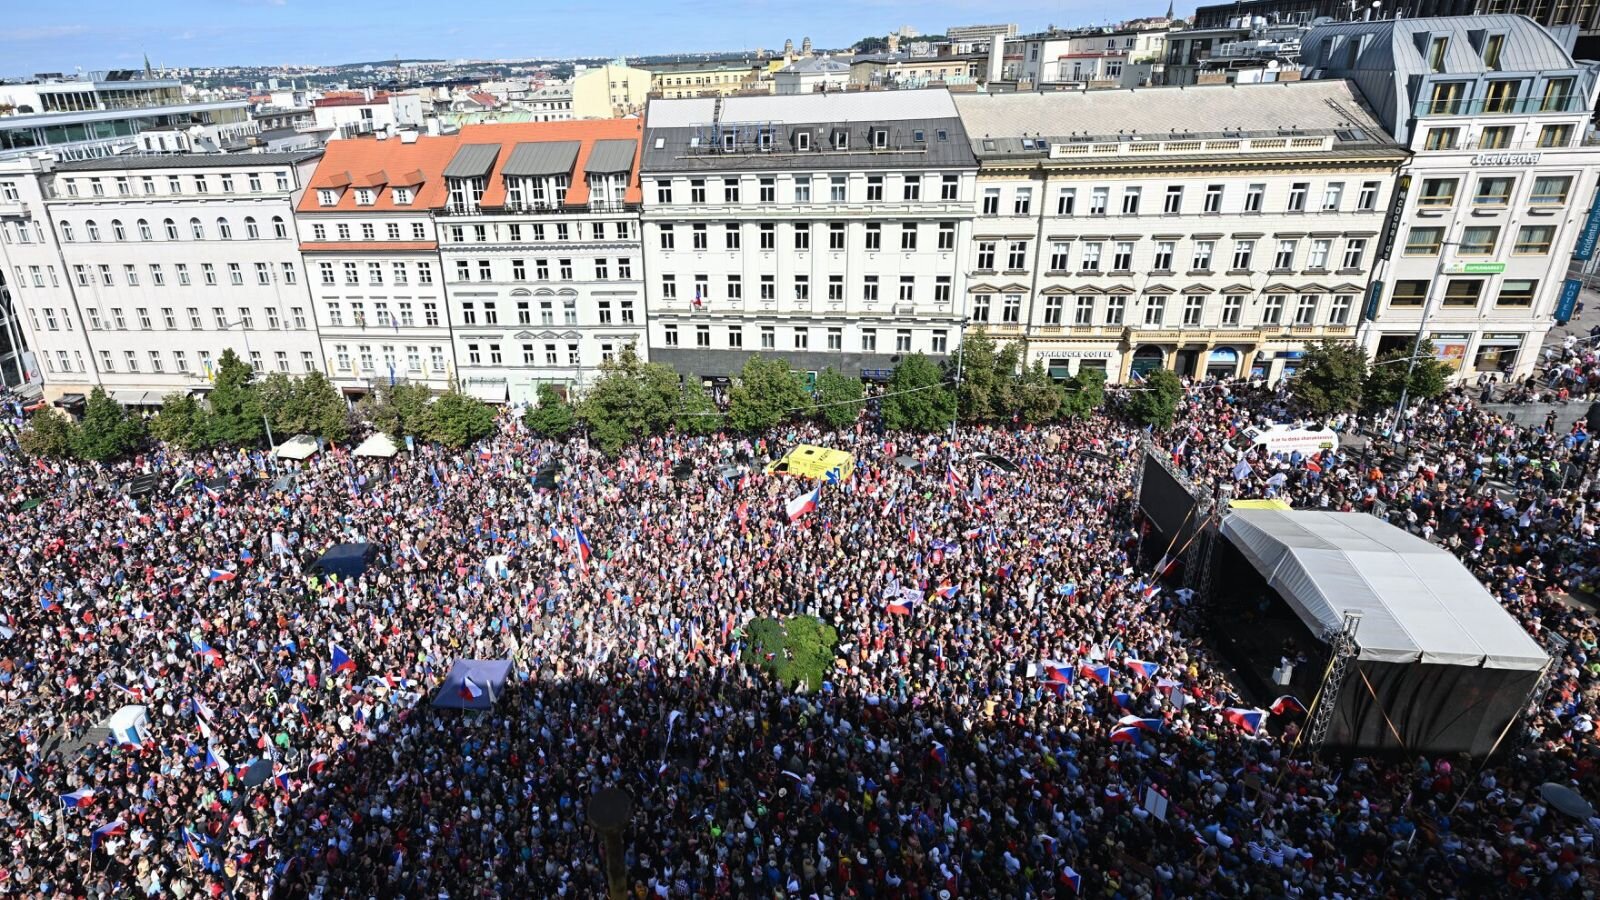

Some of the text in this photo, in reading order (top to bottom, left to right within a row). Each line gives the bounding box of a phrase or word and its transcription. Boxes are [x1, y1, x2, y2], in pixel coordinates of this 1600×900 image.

[1471, 153, 1541, 165] Occidental
[1581, 224, 1598, 256] Occidental
[1561, 283, 1576, 317] HOTEL
